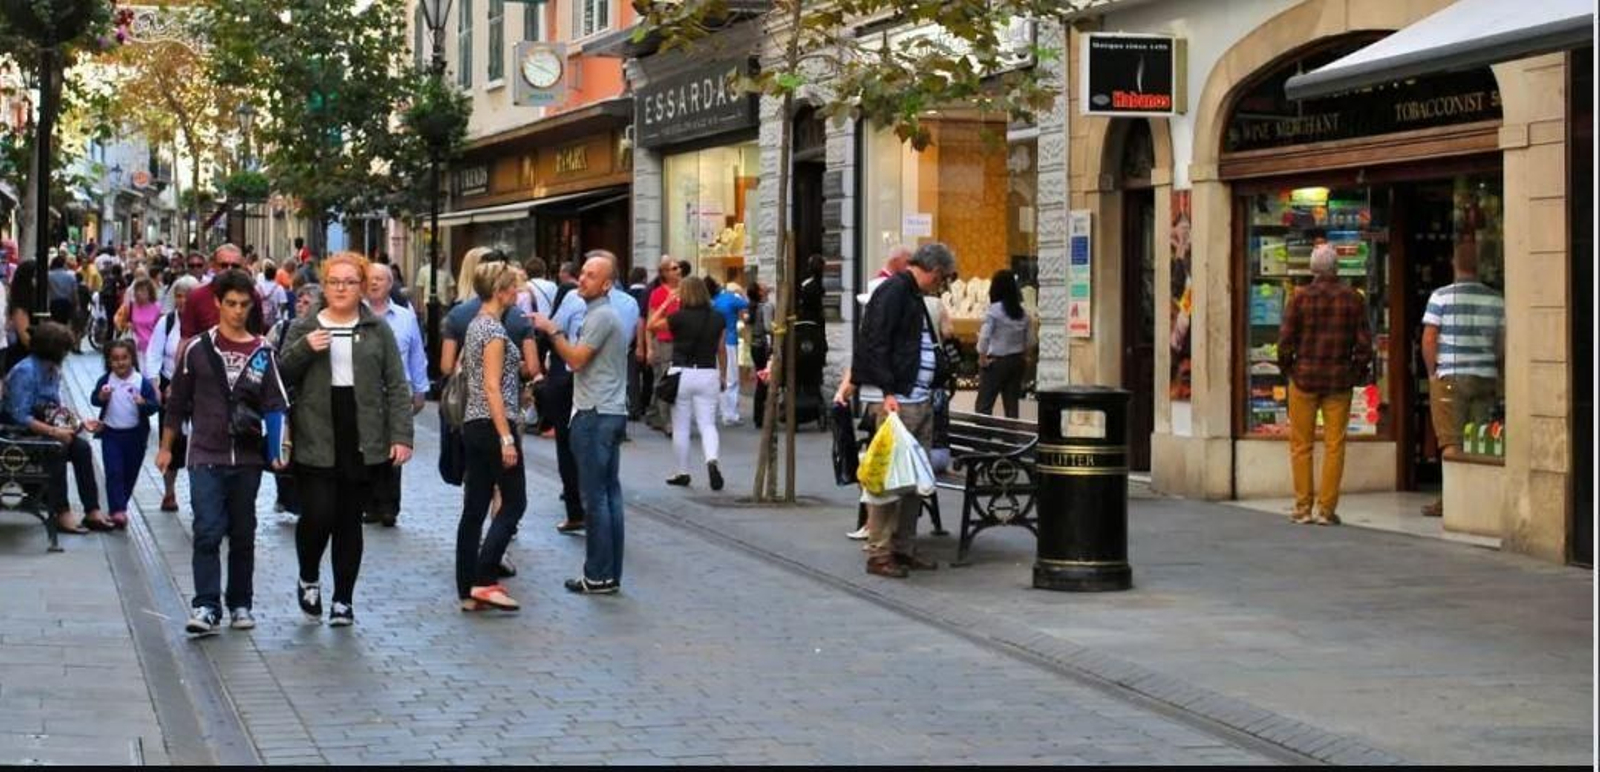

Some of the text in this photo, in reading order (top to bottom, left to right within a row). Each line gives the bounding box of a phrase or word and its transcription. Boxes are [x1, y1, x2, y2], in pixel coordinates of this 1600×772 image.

[1112, 90, 1170, 108] Habanos
[1394, 91, 1485, 121] TOBACCONIST
[1051, 453, 1095, 467] LITTER
